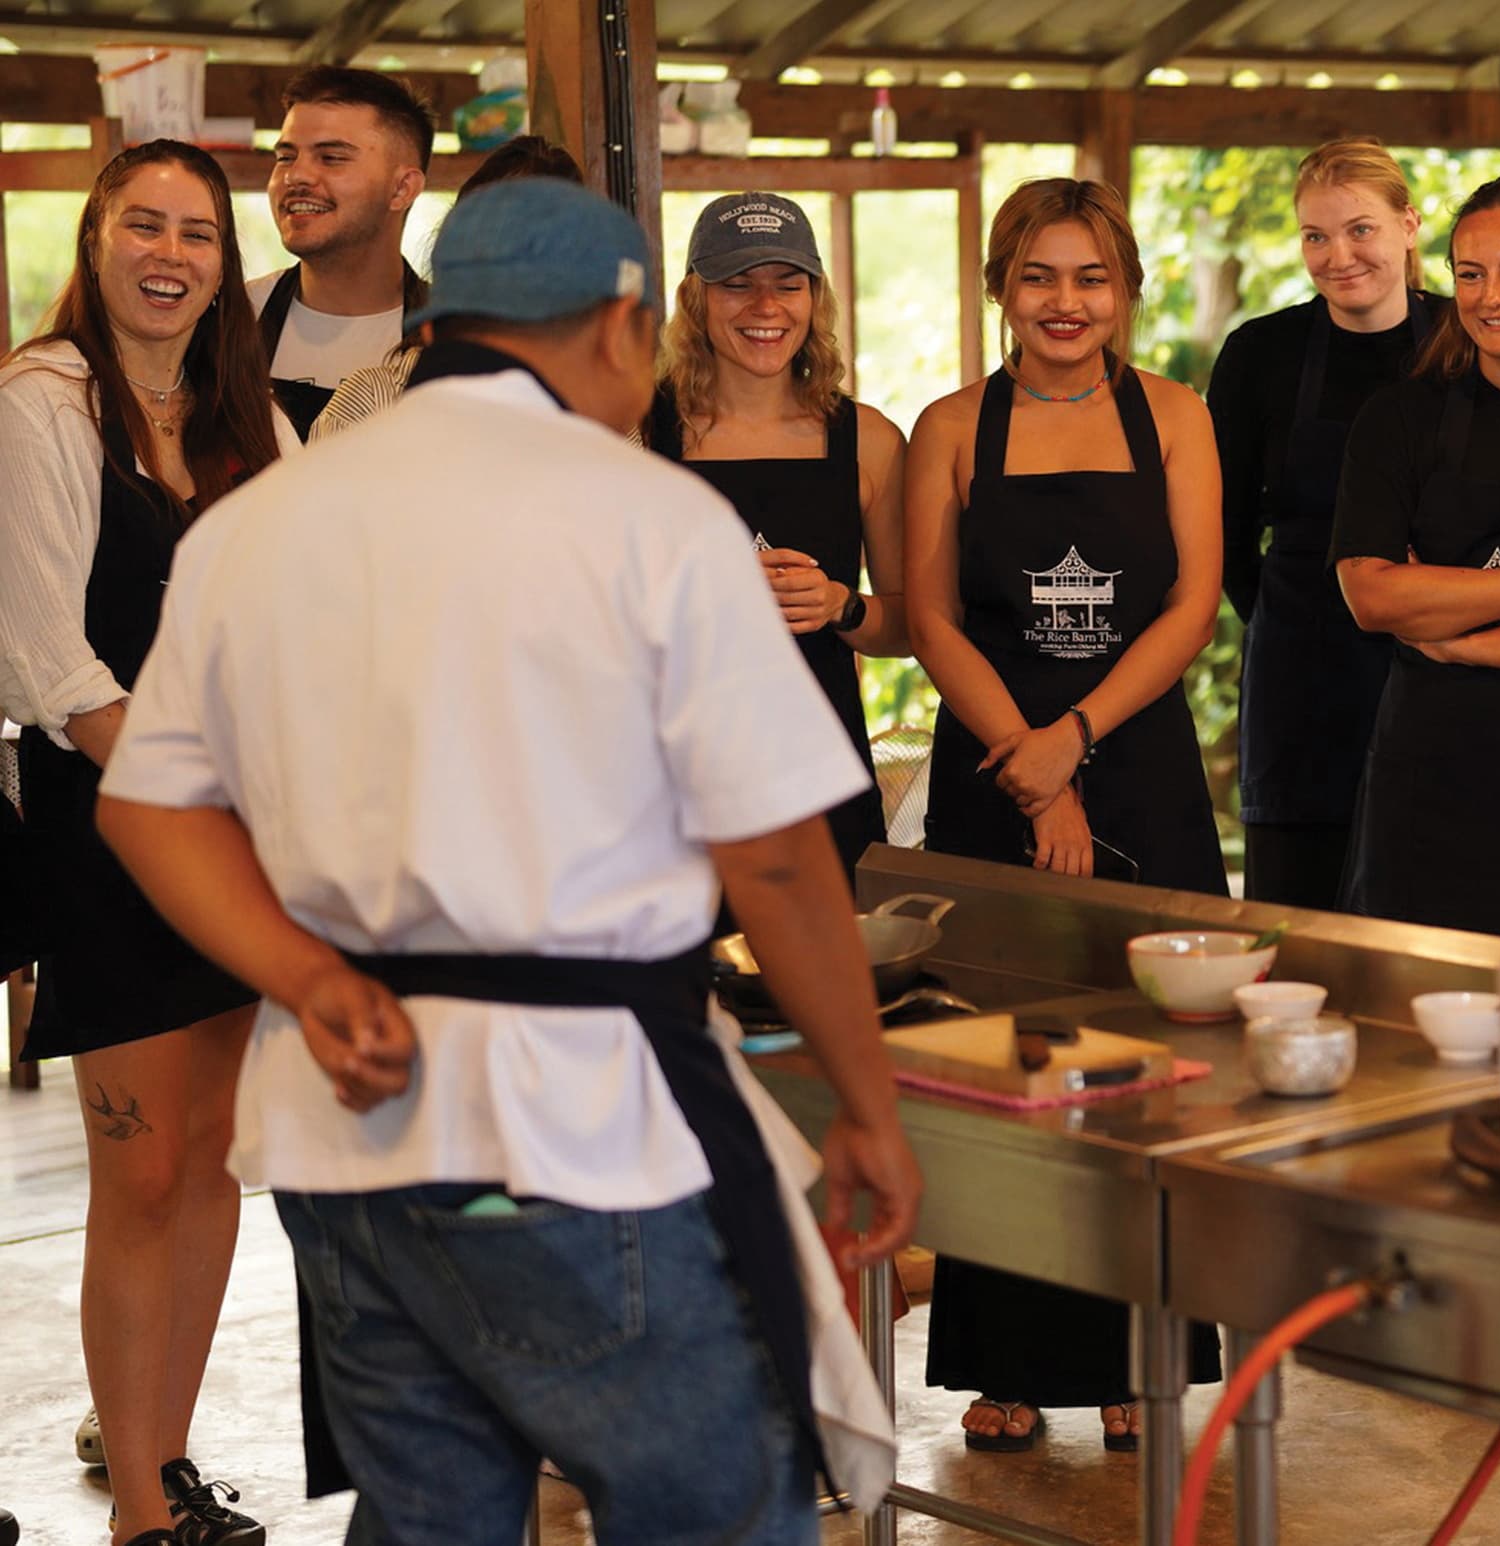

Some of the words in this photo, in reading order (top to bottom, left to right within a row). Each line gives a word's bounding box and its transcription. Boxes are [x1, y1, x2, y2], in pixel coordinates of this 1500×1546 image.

[718, 203, 768, 223] HOLLYWOOD
[769, 206, 797, 223] BEACH
[1023, 630, 1045, 641] The
[1047, 631, 1070, 642] Rice
[1071, 631, 1097, 642] Barn
[1097, 631, 1122, 642] Thai
